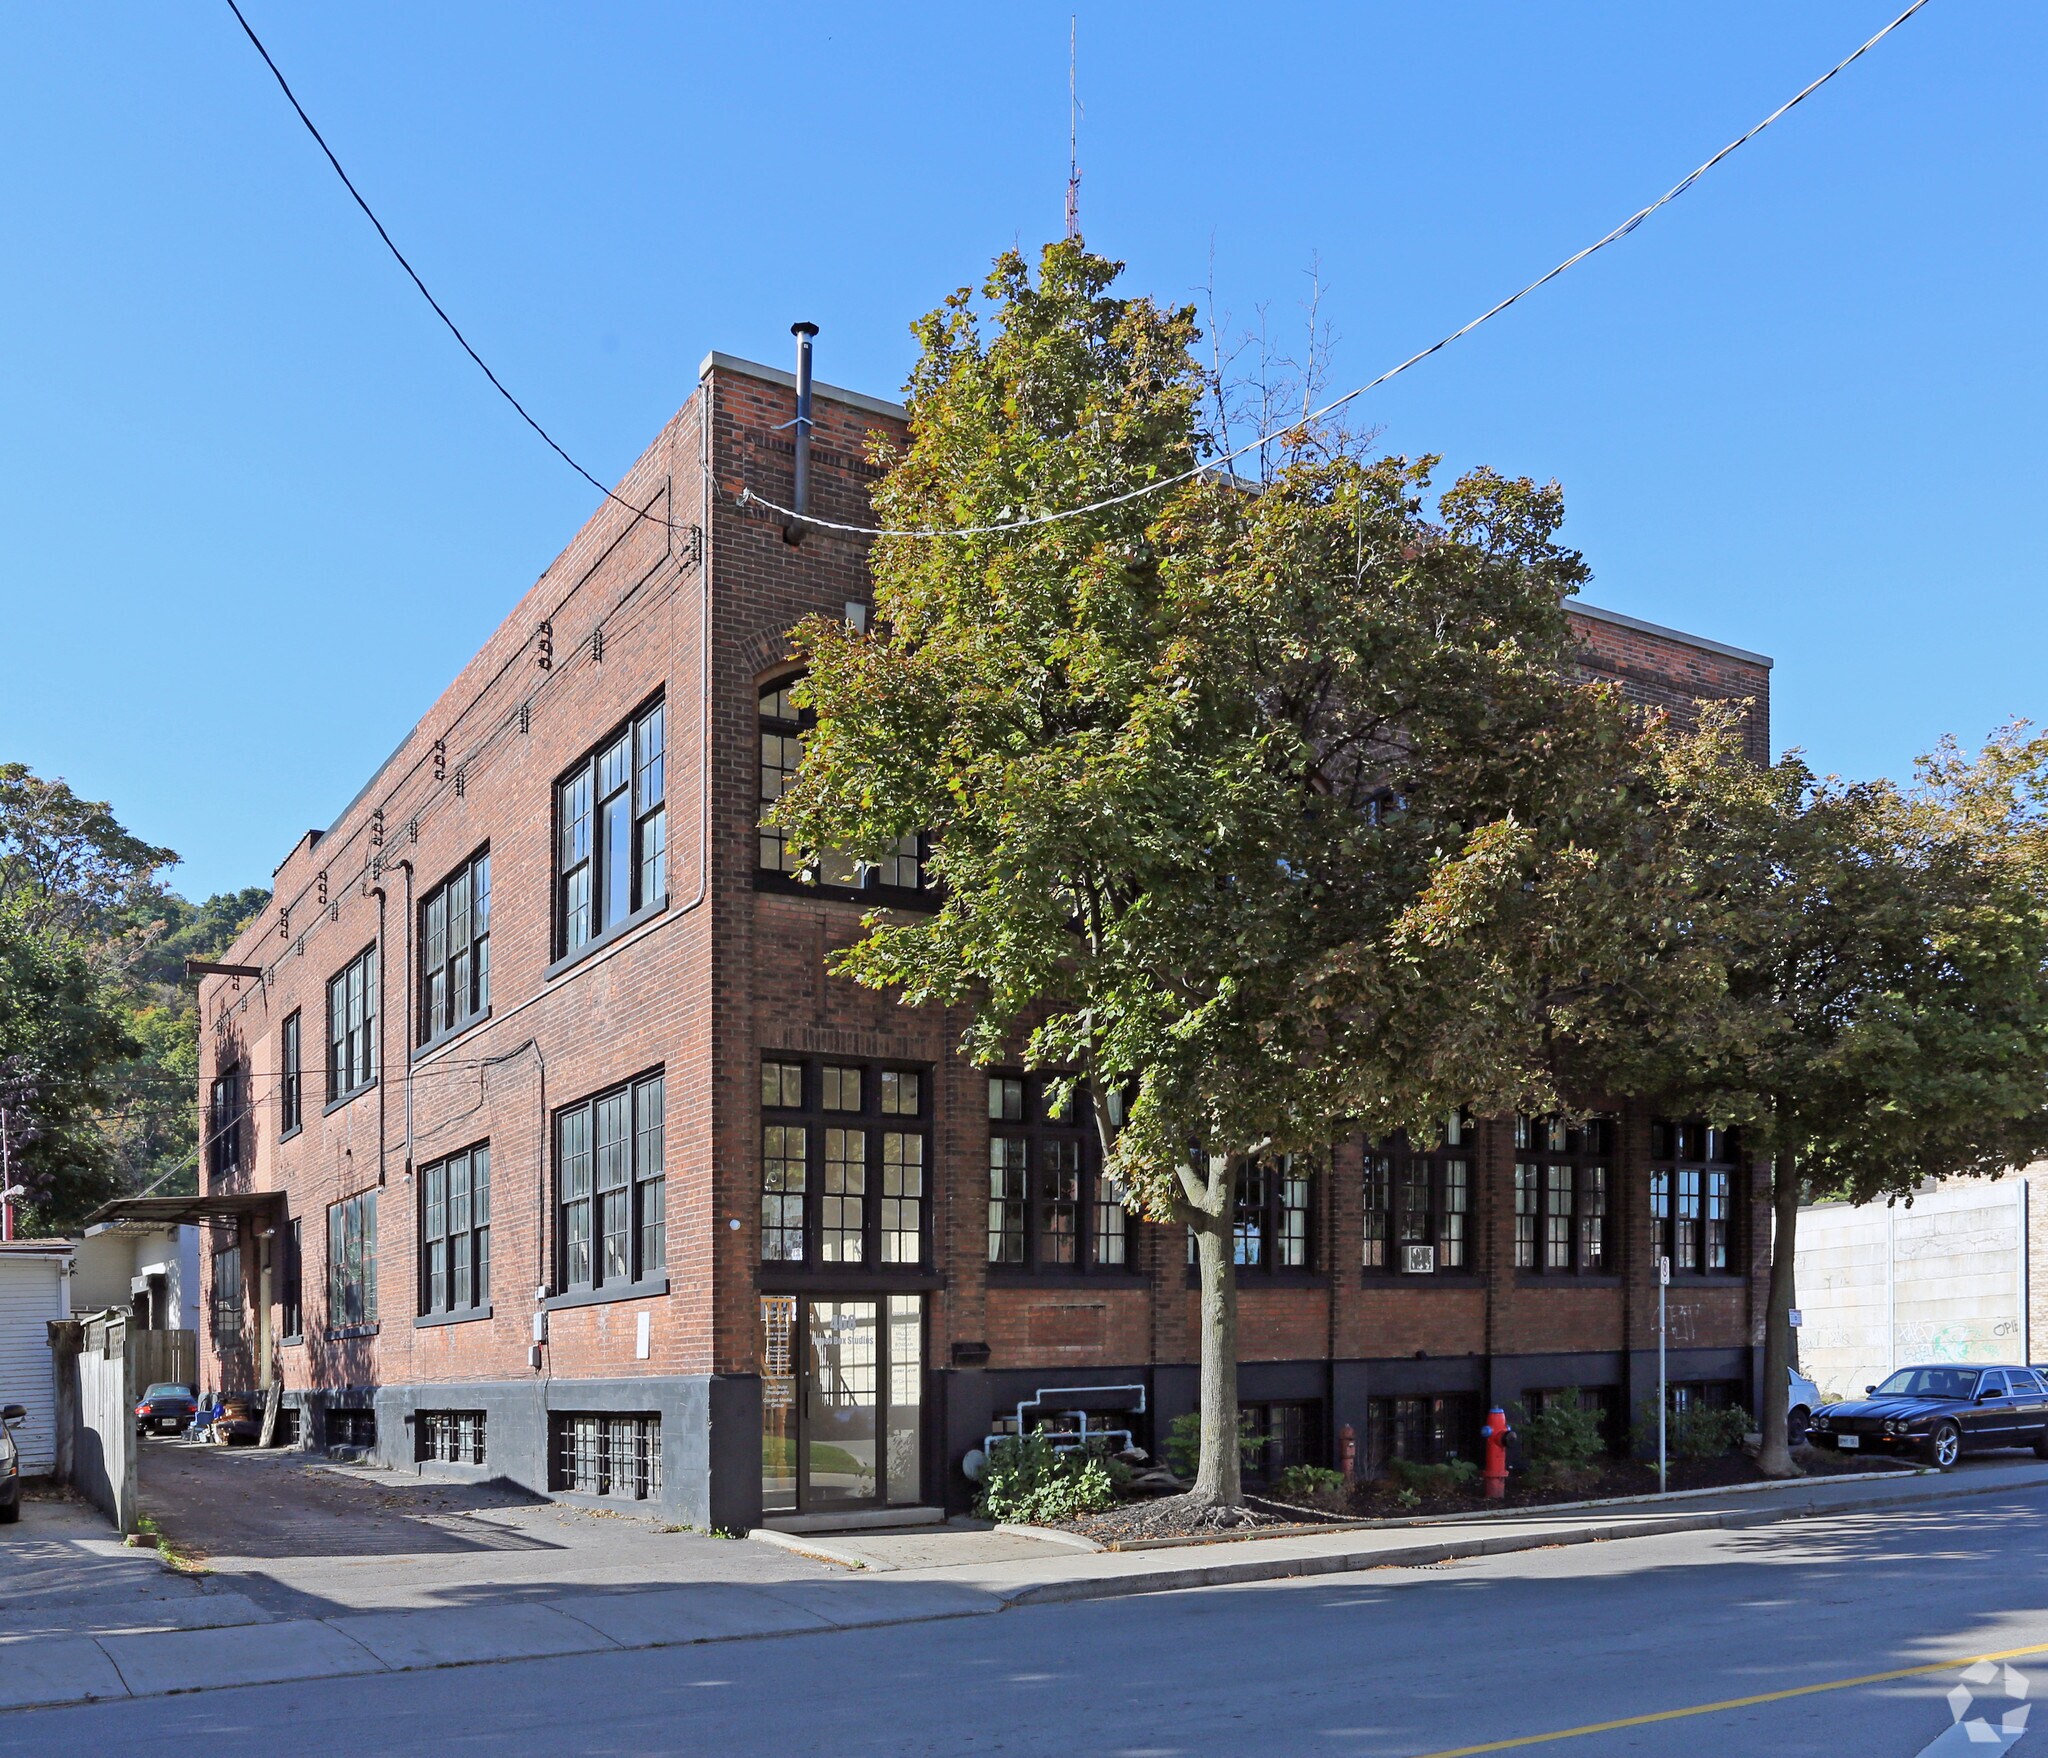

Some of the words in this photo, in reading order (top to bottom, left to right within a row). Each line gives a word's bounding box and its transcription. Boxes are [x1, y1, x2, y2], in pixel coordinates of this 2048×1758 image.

[830, 1314, 857, 1331] 468
[833, 1336, 847, 1345] Box
[847, 1335, 874, 1345] Studios
